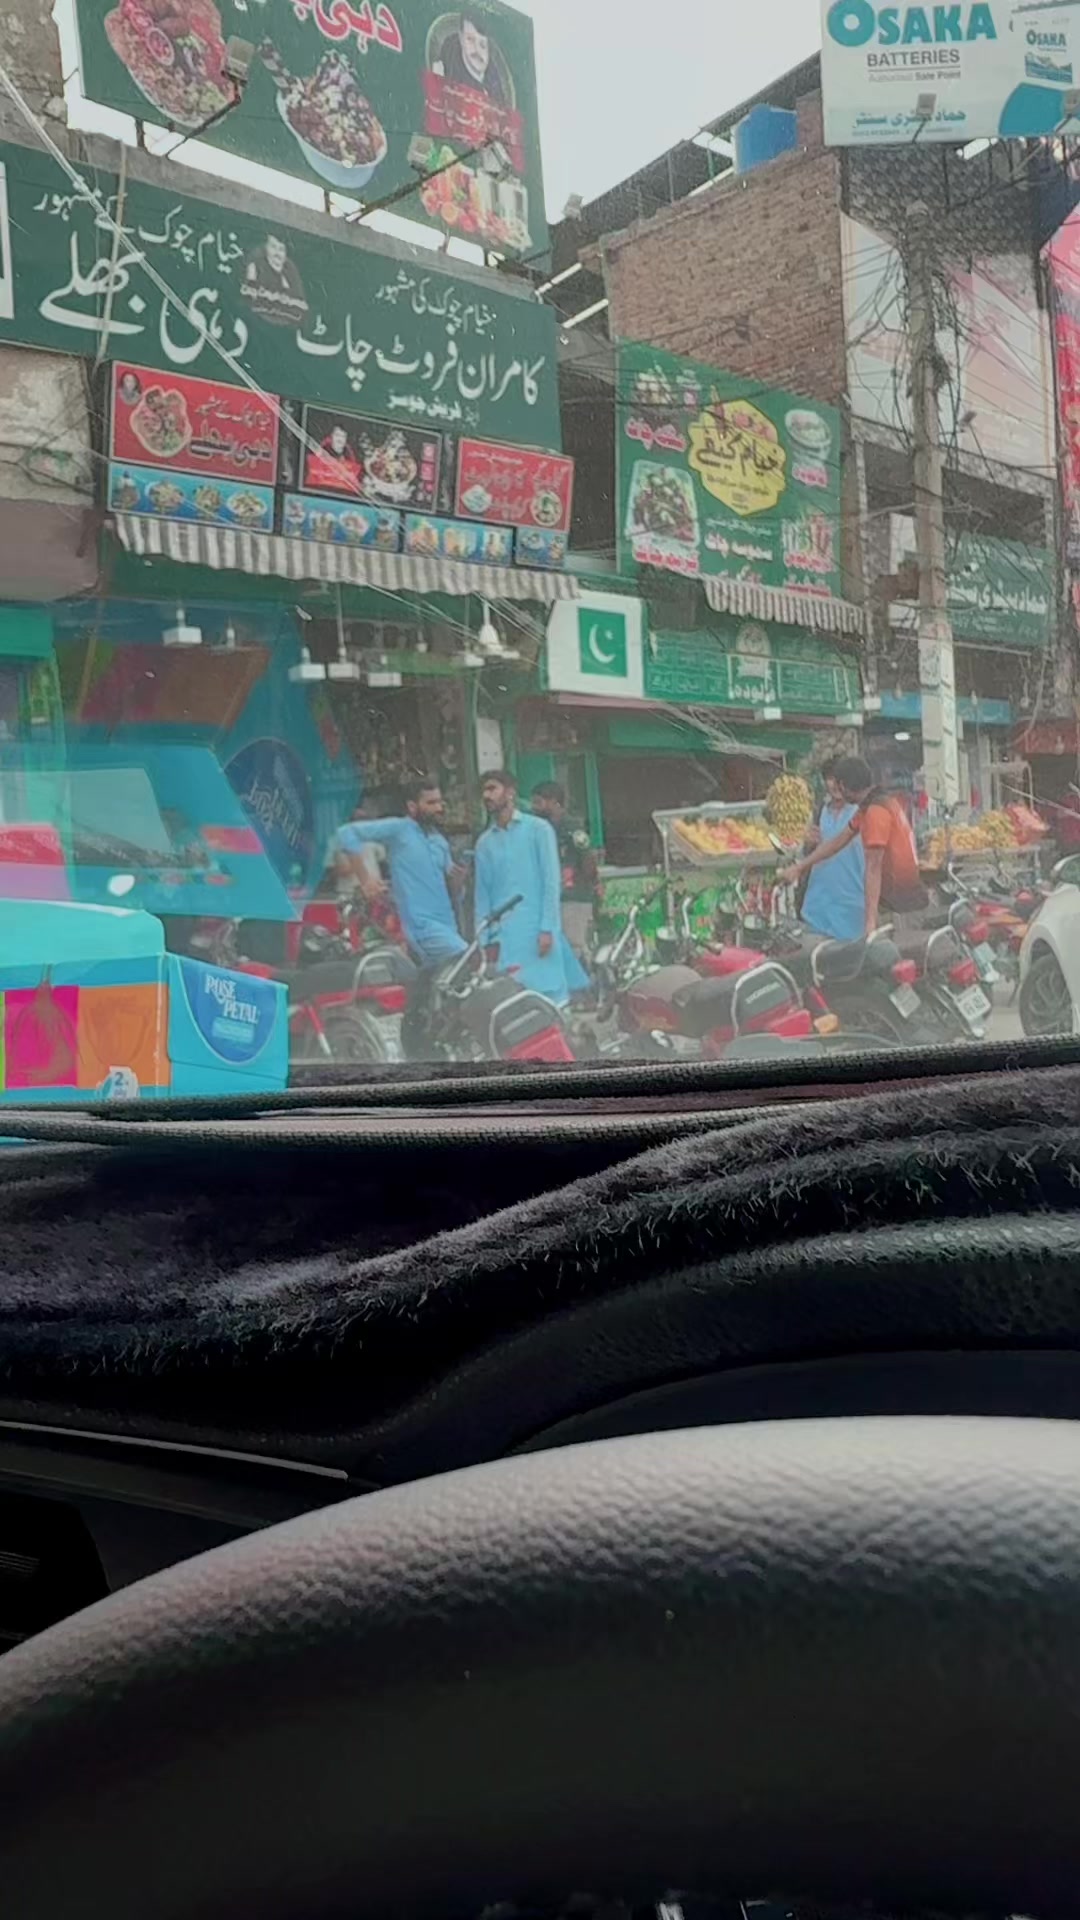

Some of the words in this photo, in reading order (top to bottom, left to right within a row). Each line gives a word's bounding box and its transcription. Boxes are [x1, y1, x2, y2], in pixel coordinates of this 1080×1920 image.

[827, 0, 997, 47] OSAKA
[867, 49, 960, 67] BATTERIES
[138, 203, 194, 263] چوک
[198, 230, 243, 274] خیام
[38, 231, 147, 335] بھلے
[374, 267, 416, 304] مشہور
[410, 277, 432, 314] کی
[159, 287, 249, 365] دہی
[427, 286, 463, 328] چوک
[463, 303, 497, 335] خیام
[295, 313, 373, 392] چاٹ
[375, 324, 458, 392] فروٹ
[457, 353, 546, 405] کامران
[204, 972, 237, 1005] ROSE
[223, 1000, 259, 1025] PETAL
